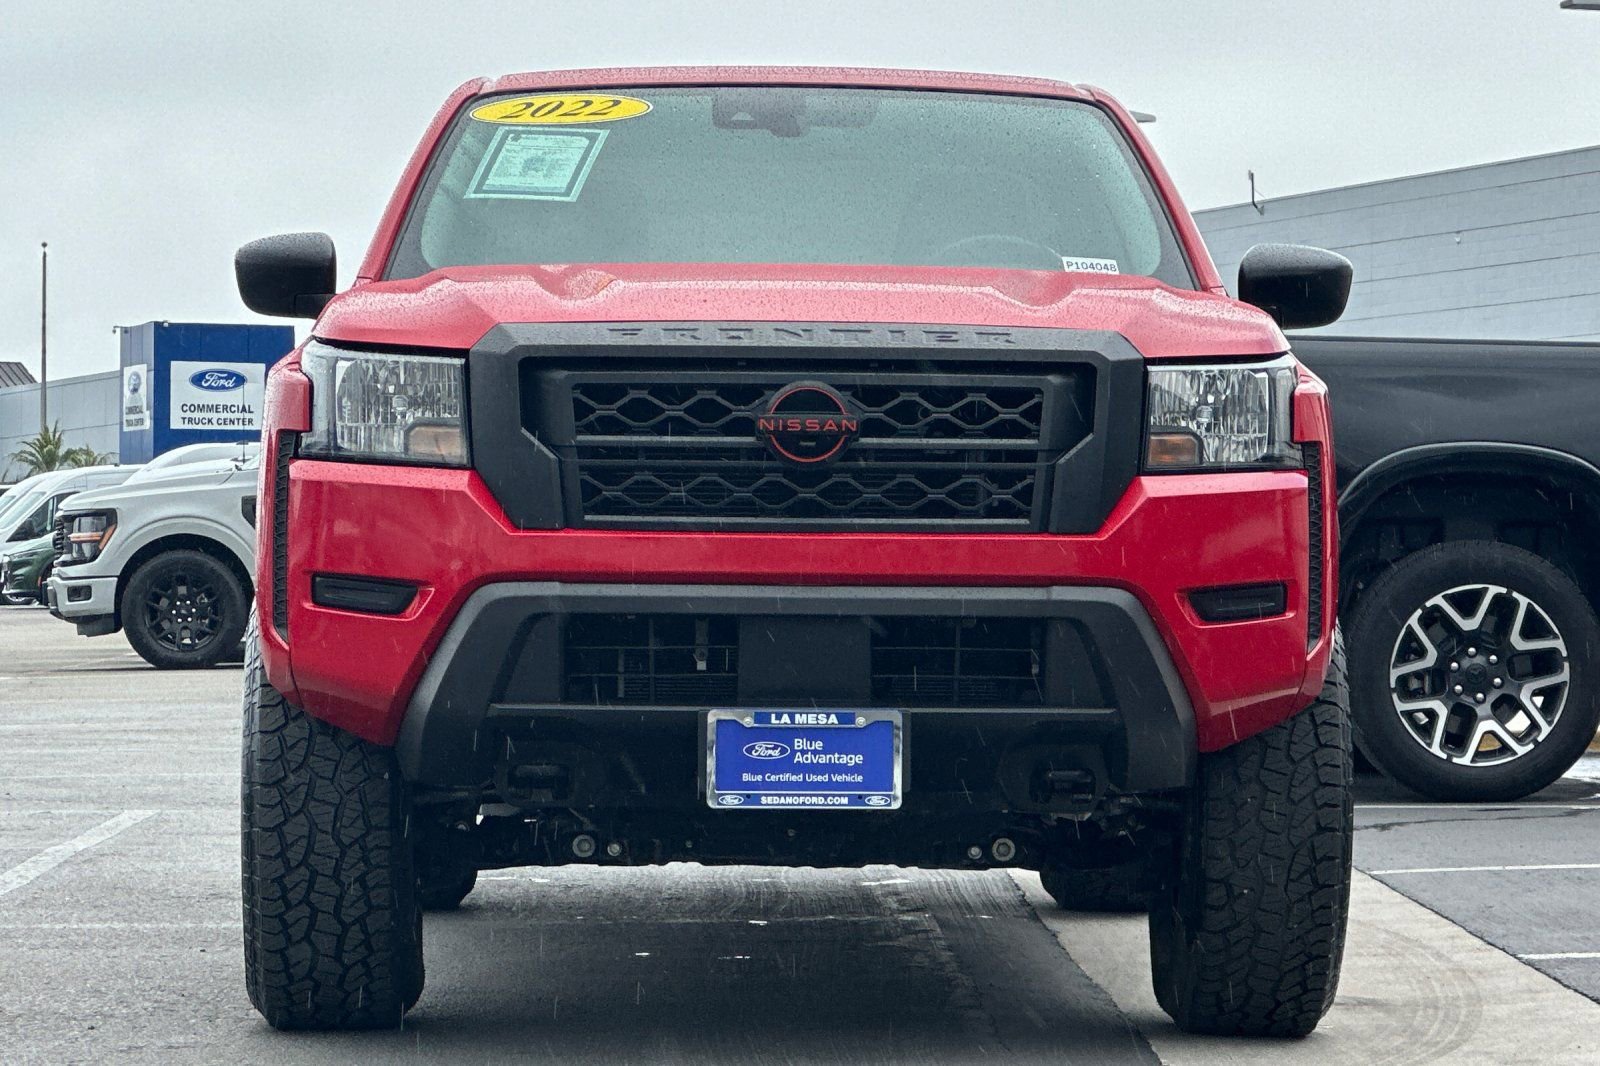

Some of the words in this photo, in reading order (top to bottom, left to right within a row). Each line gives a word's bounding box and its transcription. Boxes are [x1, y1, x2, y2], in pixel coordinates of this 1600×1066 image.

[497, 99, 622, 119] 2022
[607, 328, 1016, 344] FRONTIER
[202, 372, 236, 387] Ford
[181, 404, 254, 413] COMMERCIAL
[181, 417, 214, 425] TRUCK
[217, 418, 254, 426] CENTER
[759, 419, 857, 431] NISSAN
[770, 714, 790, 724] LA
[795, 714, 838, 724] MESA
[794, 738, 823, 750] Blue
[752, 744, 781, 757] Ford
[794, 752, 863, 766] Advantage
[742, 773, 762, 782] Blue
[765, 773, 802, 782] Certified
[806, 774, 828, 782] Used
[831, 774, 863, 782] Vehicle
[760, 796, 848, 805] SEDANOFORD.COM
